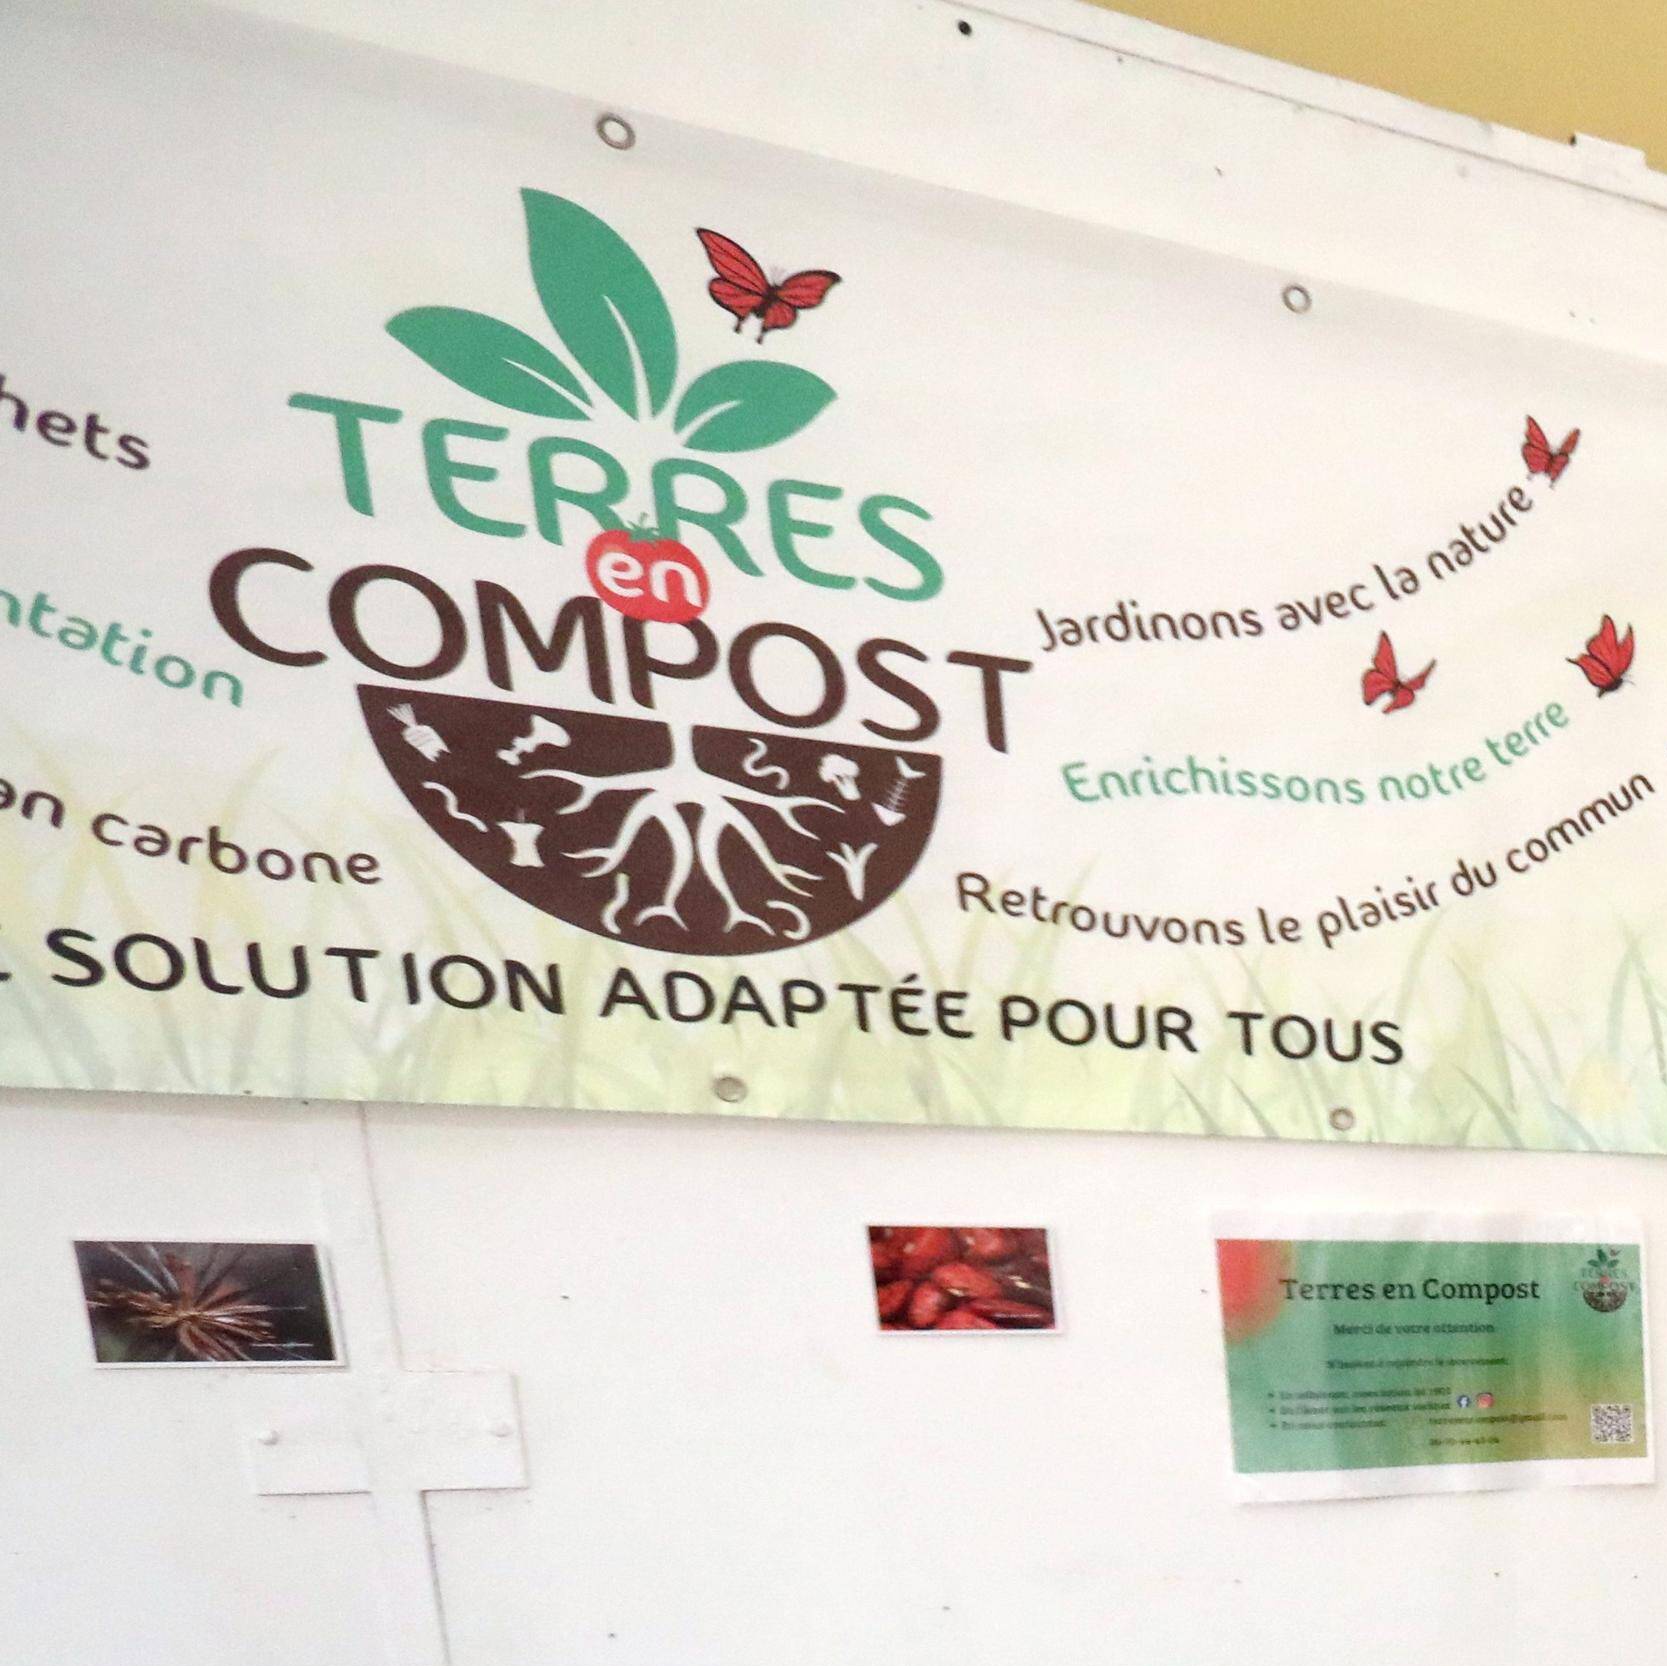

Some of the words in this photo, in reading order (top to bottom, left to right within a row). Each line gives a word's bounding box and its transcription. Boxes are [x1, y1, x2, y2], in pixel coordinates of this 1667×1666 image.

[287, 392, 945, 602] TERRES
[596, 551, 701, 611] en
[1036, 600, 1264, 652] Jardinons
[1275, 578, 1375, 632] avec
[1375, 563, 1421, 600] la
[1427, 482, 1535, 581] nature
[207, 546, 1032, 753] COMPOST
[1062, 755, 1367, 807] Enrichissons
[1378, 751, 1488, 804] notre
[1483, 699, 1571, 769] terre
[91, 812, 383, 885] carbone
[955, 871, 1247, 947] Retrouvons
[1257, 906, 1303, 945] le
[1315, 877, 1442, 949] plaisir
[1449, 857, 1498, 898] du
[1505, 770, 1656, 875] commun
[46, 927, 565, 1014] SOLUTION
[599, 966, 976, 1040] ADAPTÉE
[1000, 994, 1199, 1054] POUR
[1226, 1009, 1406, 1066] TOUS
[1278, 1278, 1375, 1301] Terres
[1382, 1283, 1415, 1301] en
[1422, 1278, 1541, 1305] Compost
